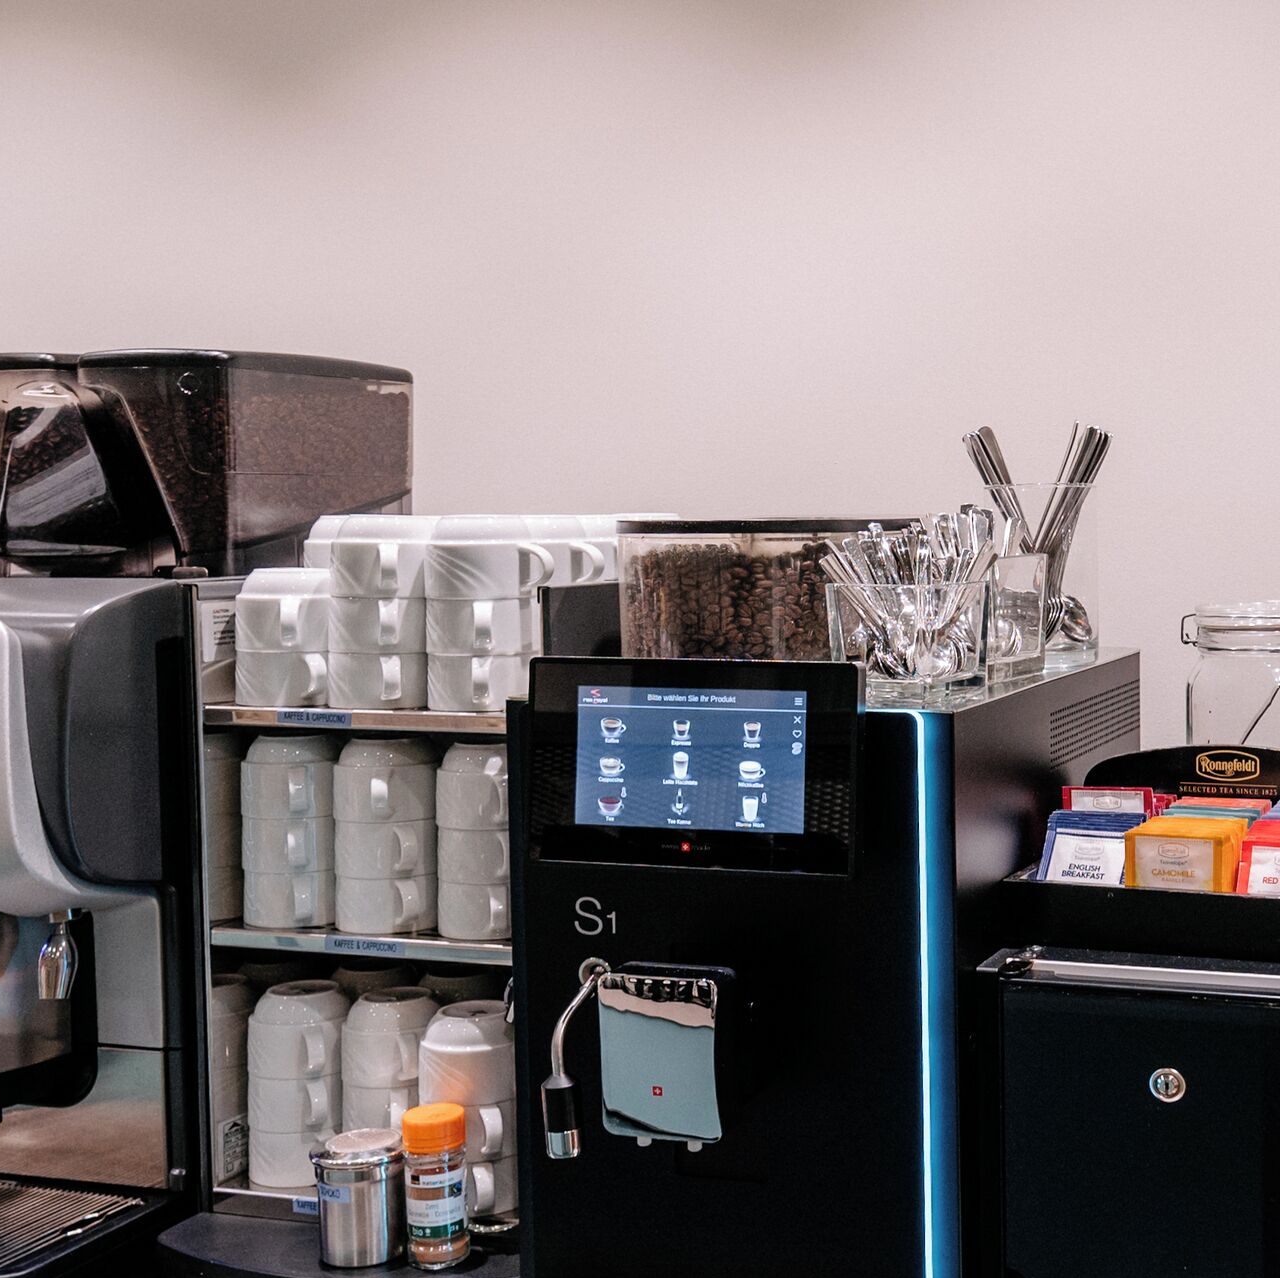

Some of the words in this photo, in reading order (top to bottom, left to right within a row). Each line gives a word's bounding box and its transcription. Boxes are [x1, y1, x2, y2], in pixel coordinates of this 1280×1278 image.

[663, 694, 687, 702] wählen
[710, 695, 736, 703] Produkt
[284, 711, 304, 721] KAFFEE
[305, 712, 310, 721] &
[311, 713, 346, 724] CAPPUCCINO
[1200, 755, 1256, 777] Ronnefeldt
[1179, 785, 1217, 793] SELECTED
[1219, 786, 1233, 794] TEA
[1236, 787, 1259, 796] SINCE
[1068, 863, 1101, 872] ENGLISH
[1061, 870, 1105, 880] BREAKFAST
[1151, 868, 1196, 878] CAMOMILE
[1262, 876, 1279, 885] RED
[574, 896, 616, 936] S1
[334, 939, 354, 950] KAFFEE
[356, 940, 360, 950] &
[362, 941, 397, 953] CAPPUCCINO
[297, 1201, 318, 1211] KAFFEE
[412, 1227, 424, 1237] bio
